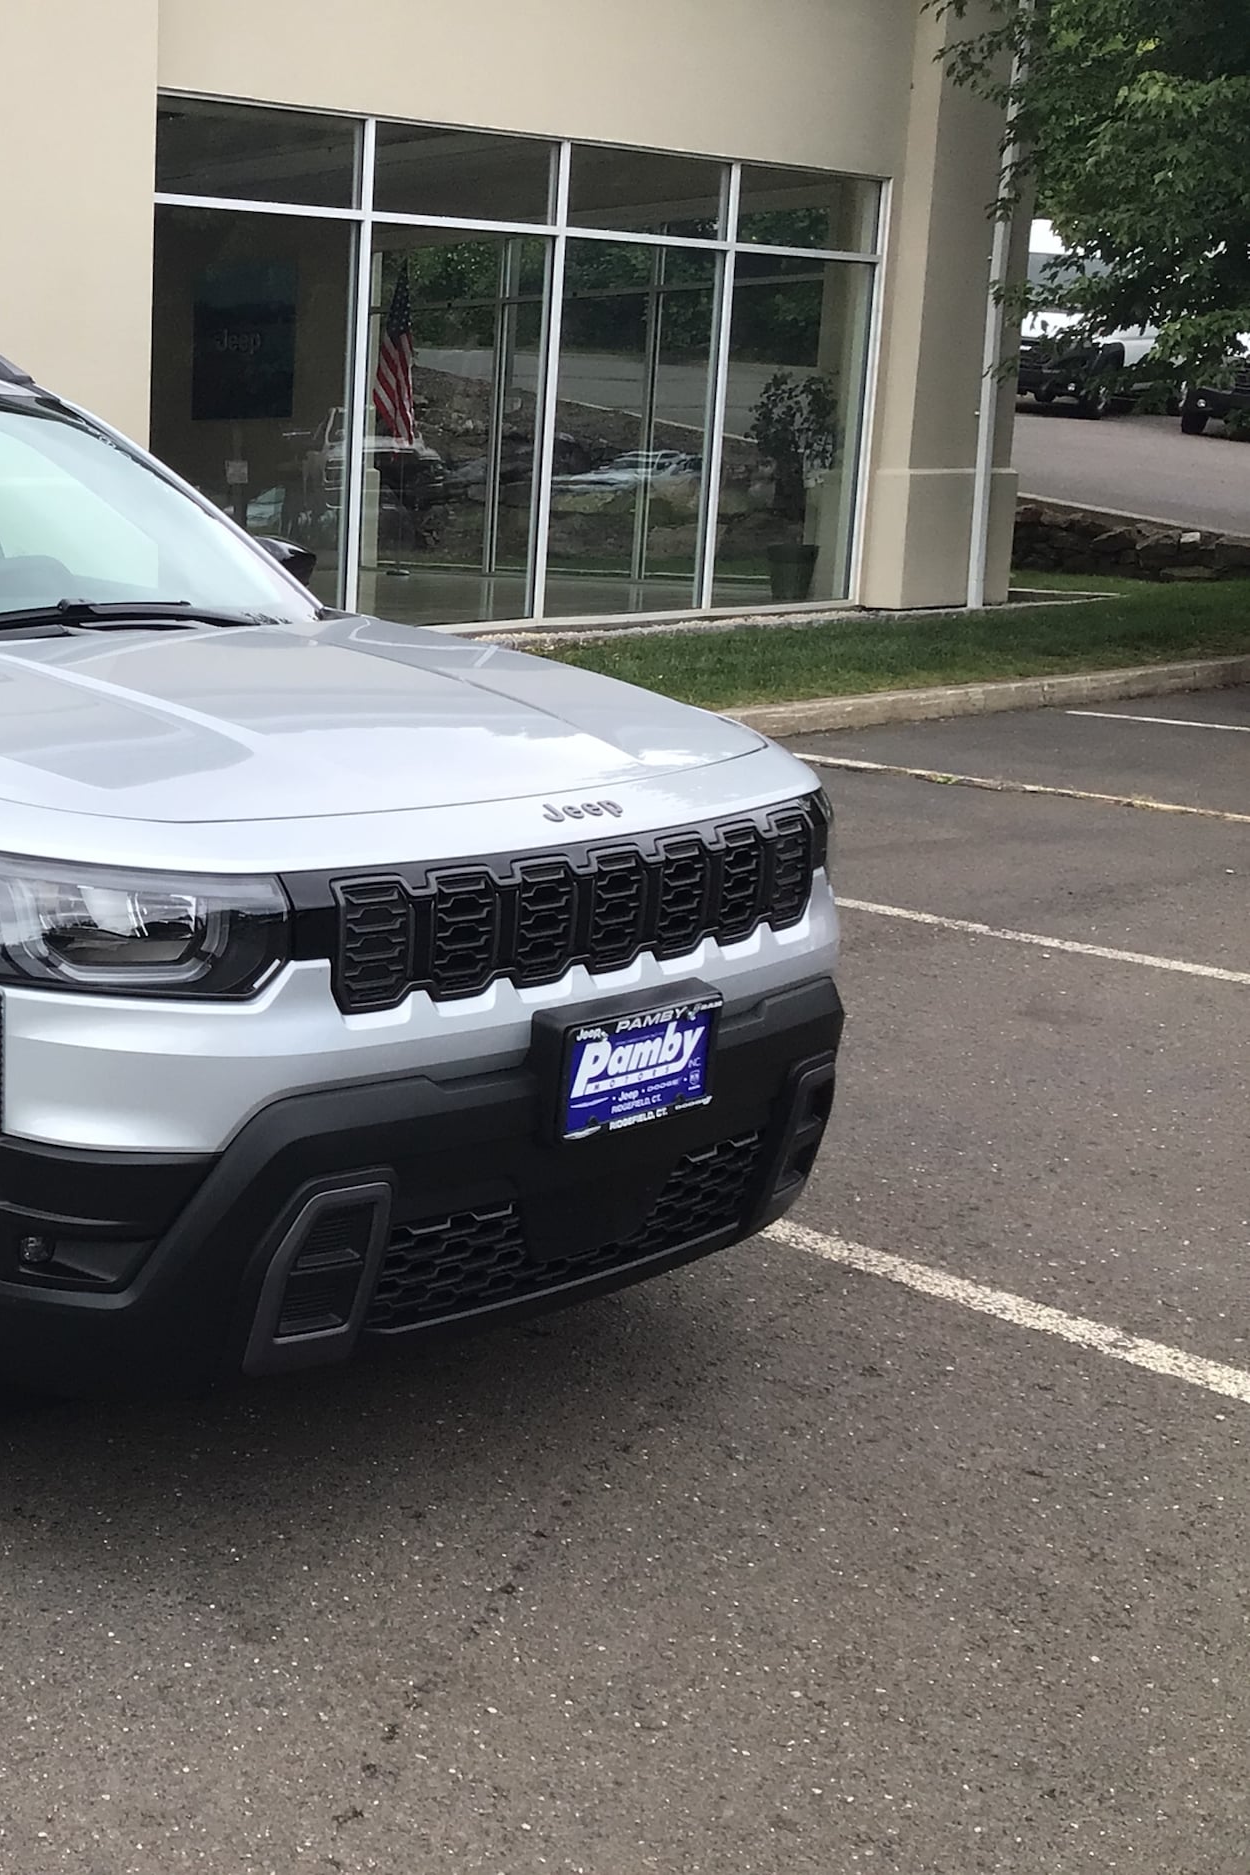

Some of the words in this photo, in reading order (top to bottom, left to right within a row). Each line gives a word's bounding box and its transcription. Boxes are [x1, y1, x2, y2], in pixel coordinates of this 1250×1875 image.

[542, 799, 624, 823] Jeep
[615, 1006, 688, 1034] PAMBY
[570, 1021, 706, 1099] Pamby
[618, 1089, 639, 1102] Jeep
